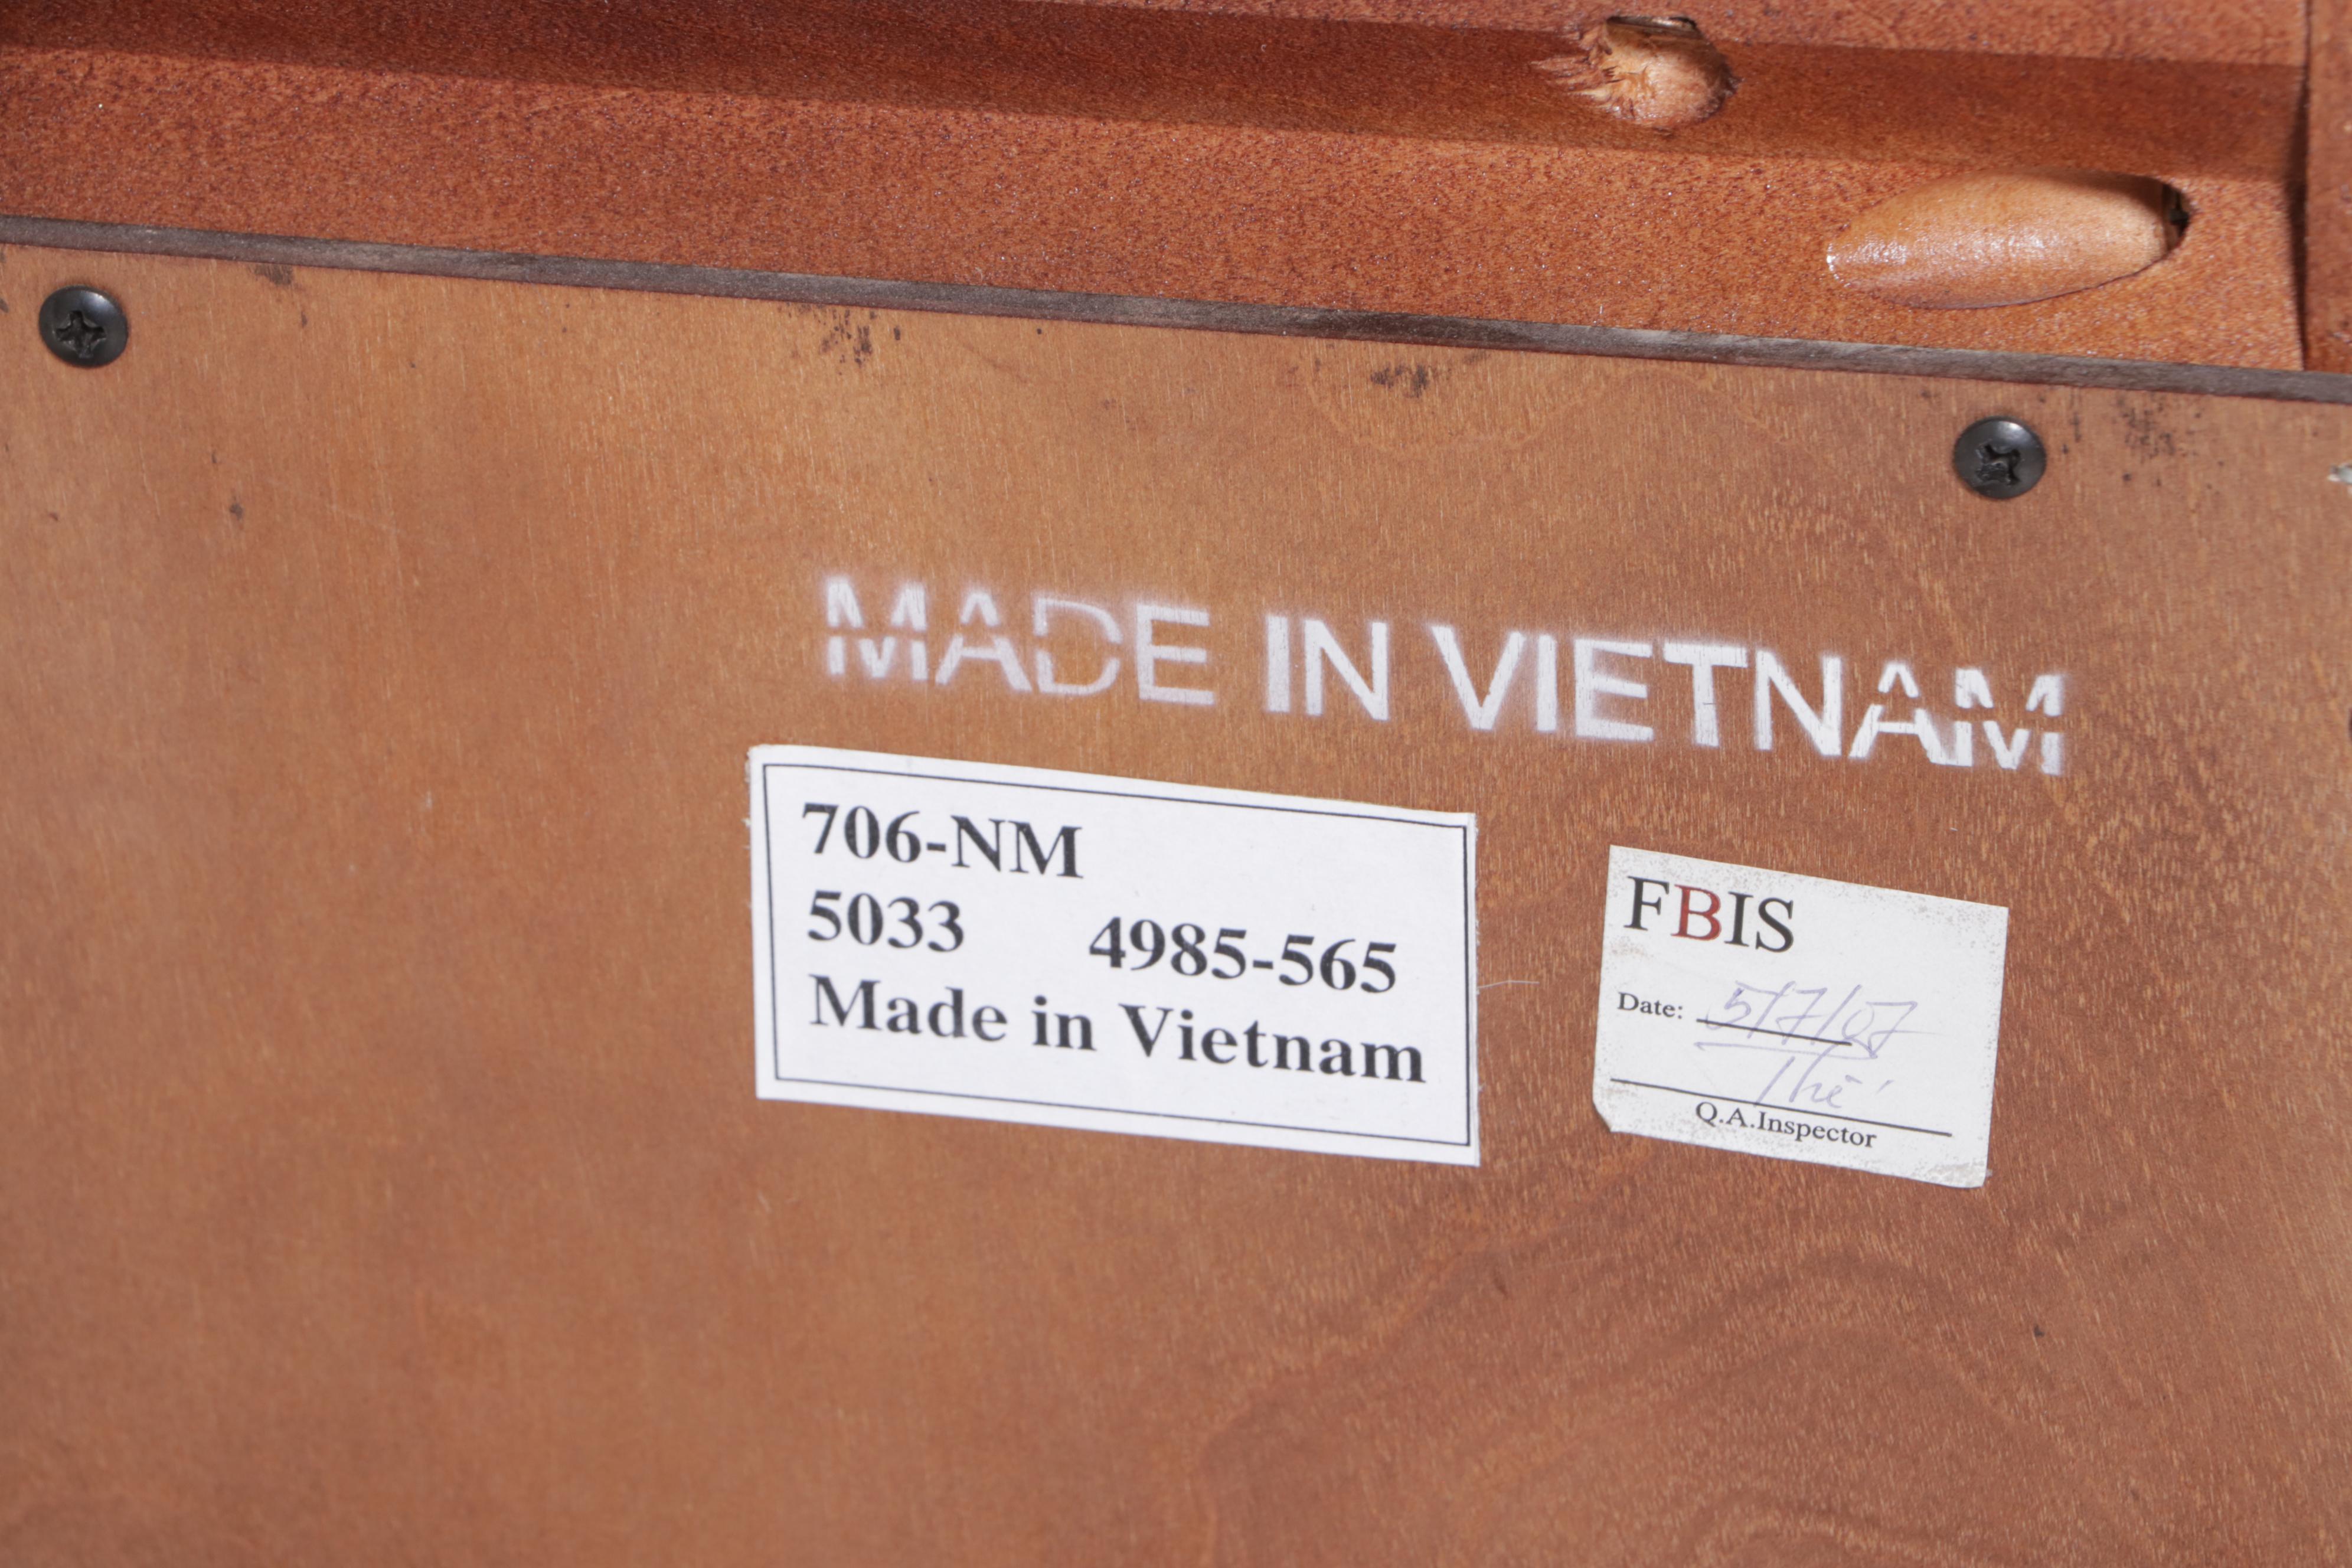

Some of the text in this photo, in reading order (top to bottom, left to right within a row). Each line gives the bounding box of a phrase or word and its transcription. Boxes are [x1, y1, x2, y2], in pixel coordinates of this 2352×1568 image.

[825, 578, 2065, 775] MADE IN VIETNAM
[802, 802, 1083, 879] 706-NM
[807, 890, 1397, 994] 5033 4985-565
[1623, 876, 1795, 953] FBIS
[809, 974, 1427, 1083] Made in Vietnam
[1617, 991, 1684, 1020] Date:
[1695, 1101, 1878, 1149] Q.A.Inspector
